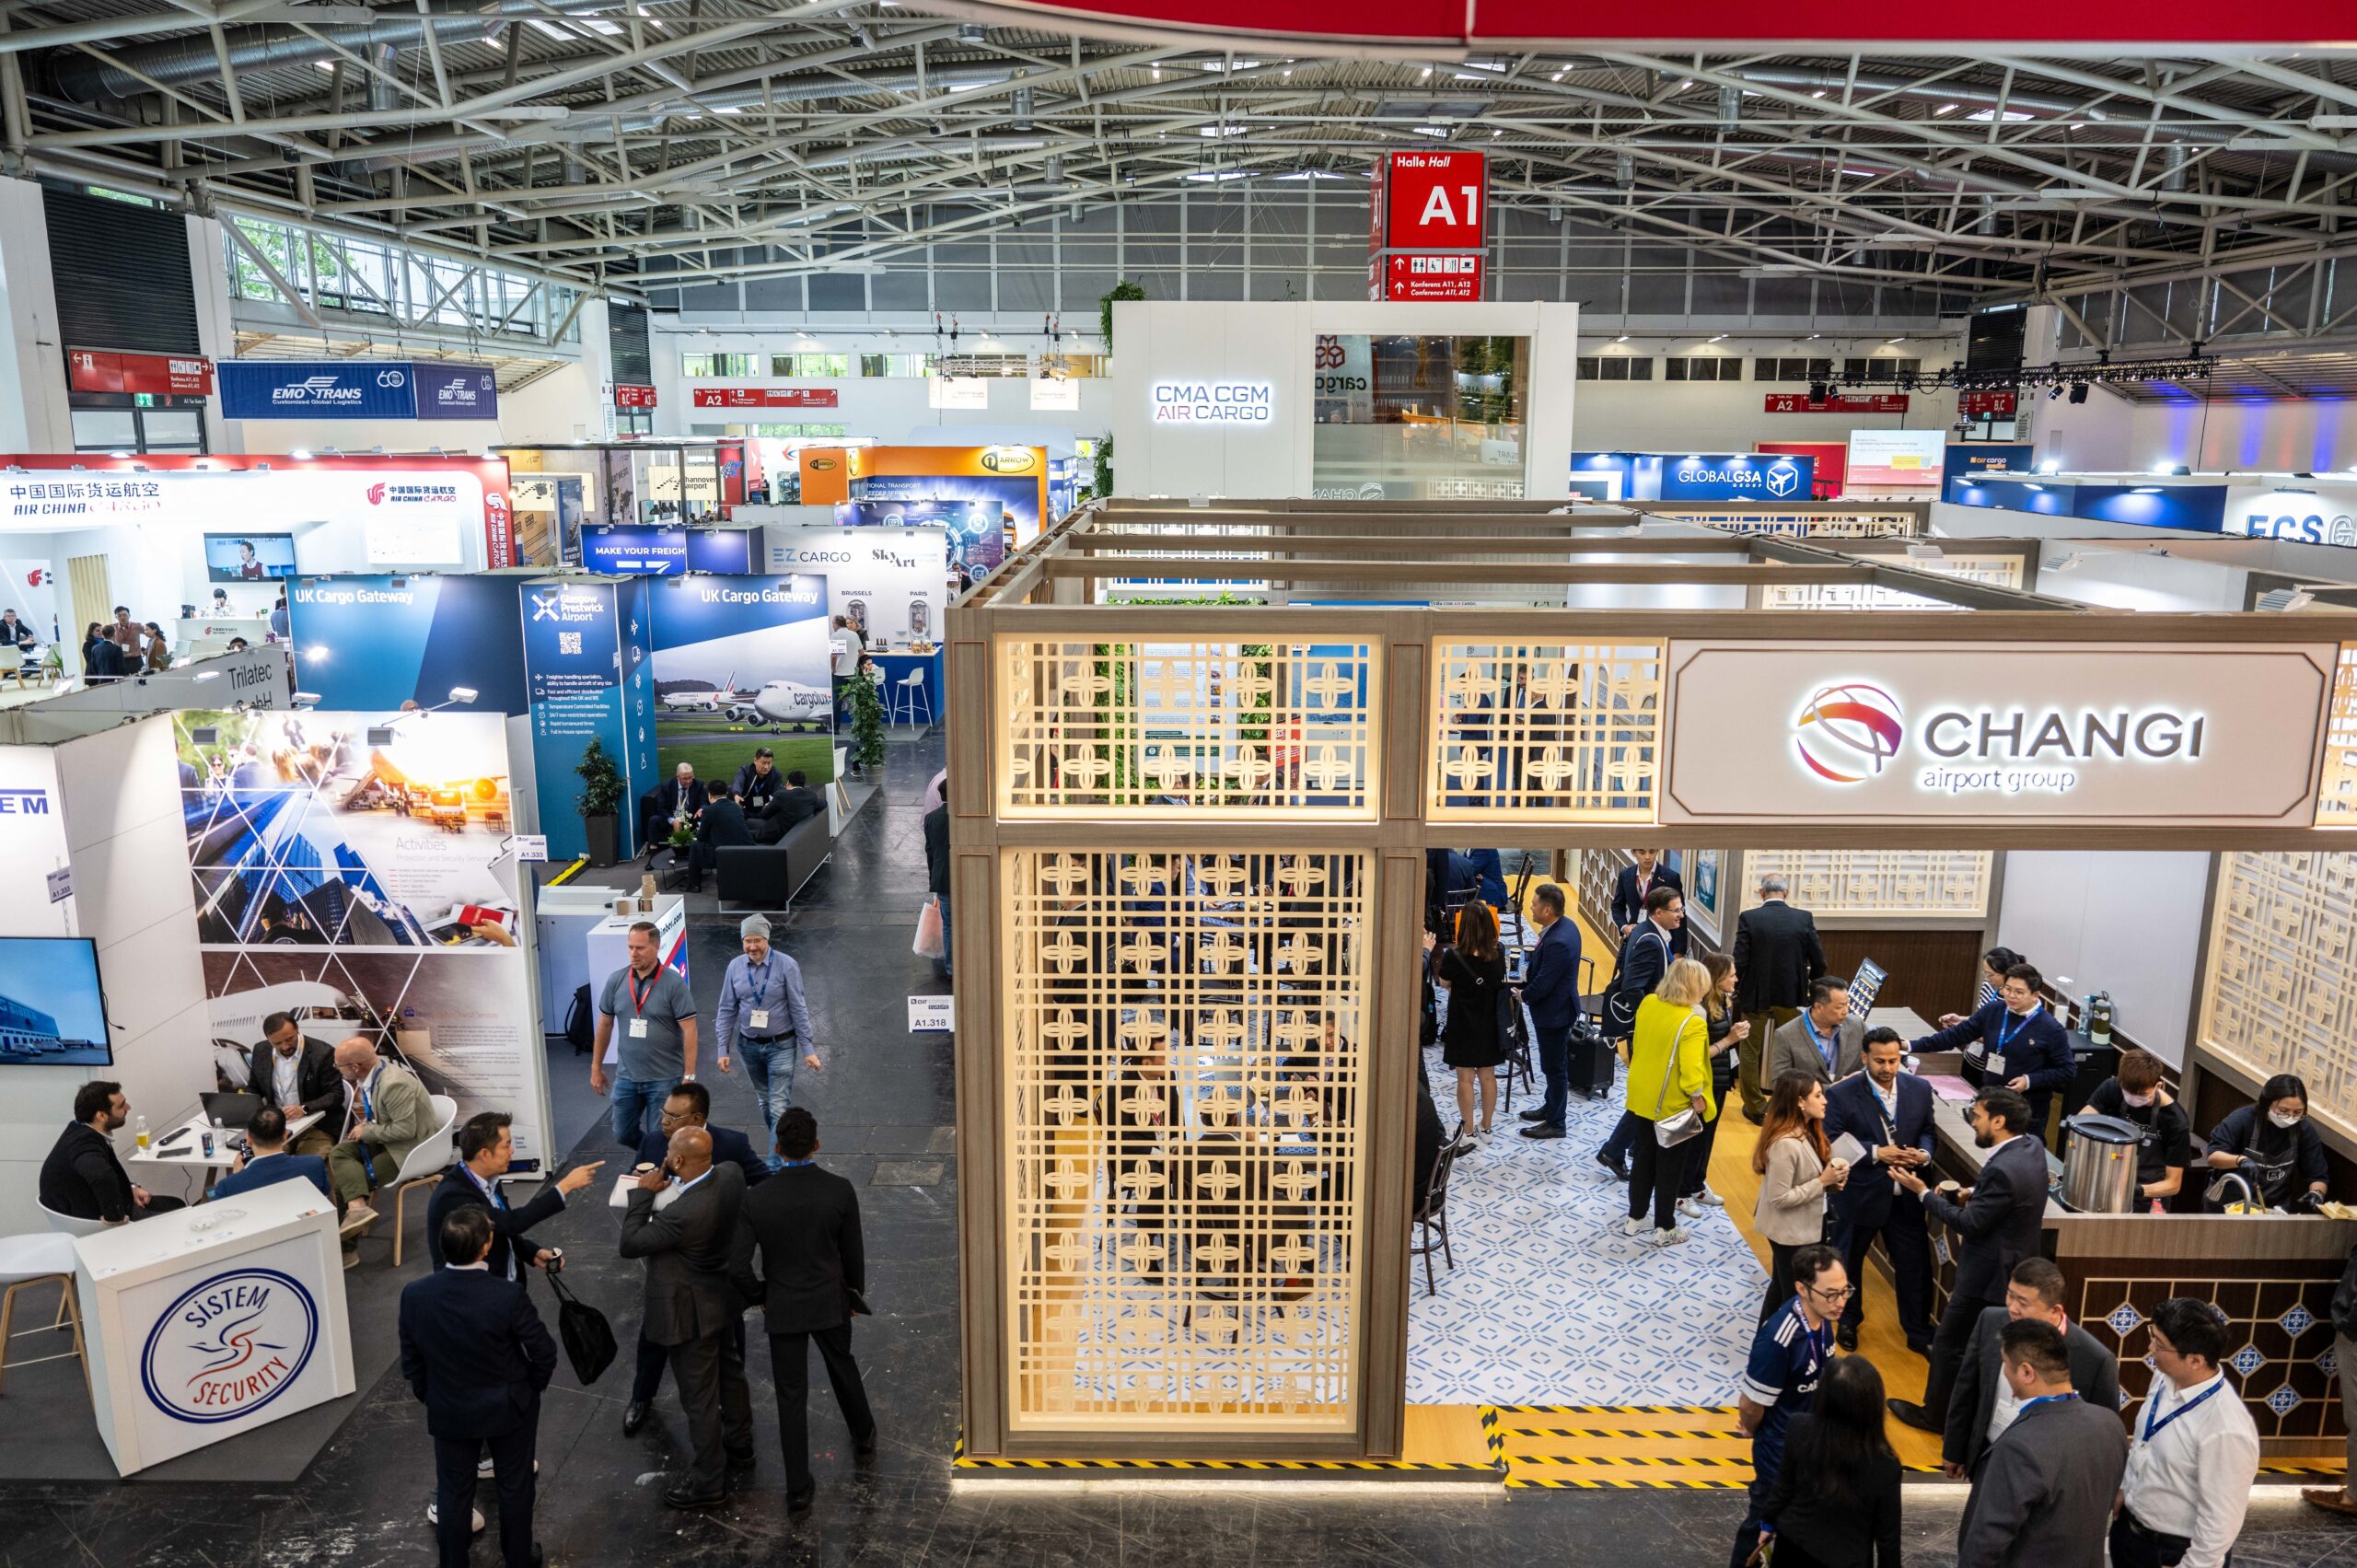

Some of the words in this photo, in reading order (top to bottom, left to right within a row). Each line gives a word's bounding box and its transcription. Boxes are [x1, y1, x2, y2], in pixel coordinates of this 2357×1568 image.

[1398, 157, 1425, 168] Halle
[1429, 157, 1451, 168] Hall
[1419, 186, 1477, 225] A1
[273, 388, 305, 400] EMO
[315, 388, 362, 400] TRANS
[438, 389, 452, 400] EMO
[457, 389, 476, 401] TRANS
[706, 396, 722, 405] A2
[1156, 386, 1210, 402] CMA
[1215, 386, 1269, 403] CGM
[1156, 405, 1190, 420] AIR
[1196, 405, 1269, 420] CARGO
[1777, 401, 1793, 411] A2
[1994, 401, 2004, 412] B,C
[10, 482, 159, 500] 中国国际货运航空
[389, 486, 456, 494] 中国国际货运航空
[14, 505, 38, 515] AIR
[42, 503, 87, 514] CHINA
[773, 549, 796, 562] EZ
[800, 552, 851, 563] CARGO
[872, 549, 896, 561] Sky
[889, 559, 916, 567] Art
[296, 589, 314, 603] UK
[317, 589, 354, 604] Cargo
[357, 589, 414, 605] Gateway
[560, 594, 597, 604] Glasgow
[701, 589, 720, 602] UK
[722, 589, 760, 604] Cargo
[762, 589, 818, 604] Gateway
[561, 603, 604, 612] Prestwick
[562, 612, 593, 622] Airport
[228, 663, 272, 691] Trilatec
[794, 692, 829, 707] cargolux
[1924, 713, 2204, 758] CHANGI
[1924, 768, 2002, 792] airport
[2007, 772, 2075, 792] group
[396, 836, 447, 851] Activities
[193, 1355, 289, 1406] SECURITY
